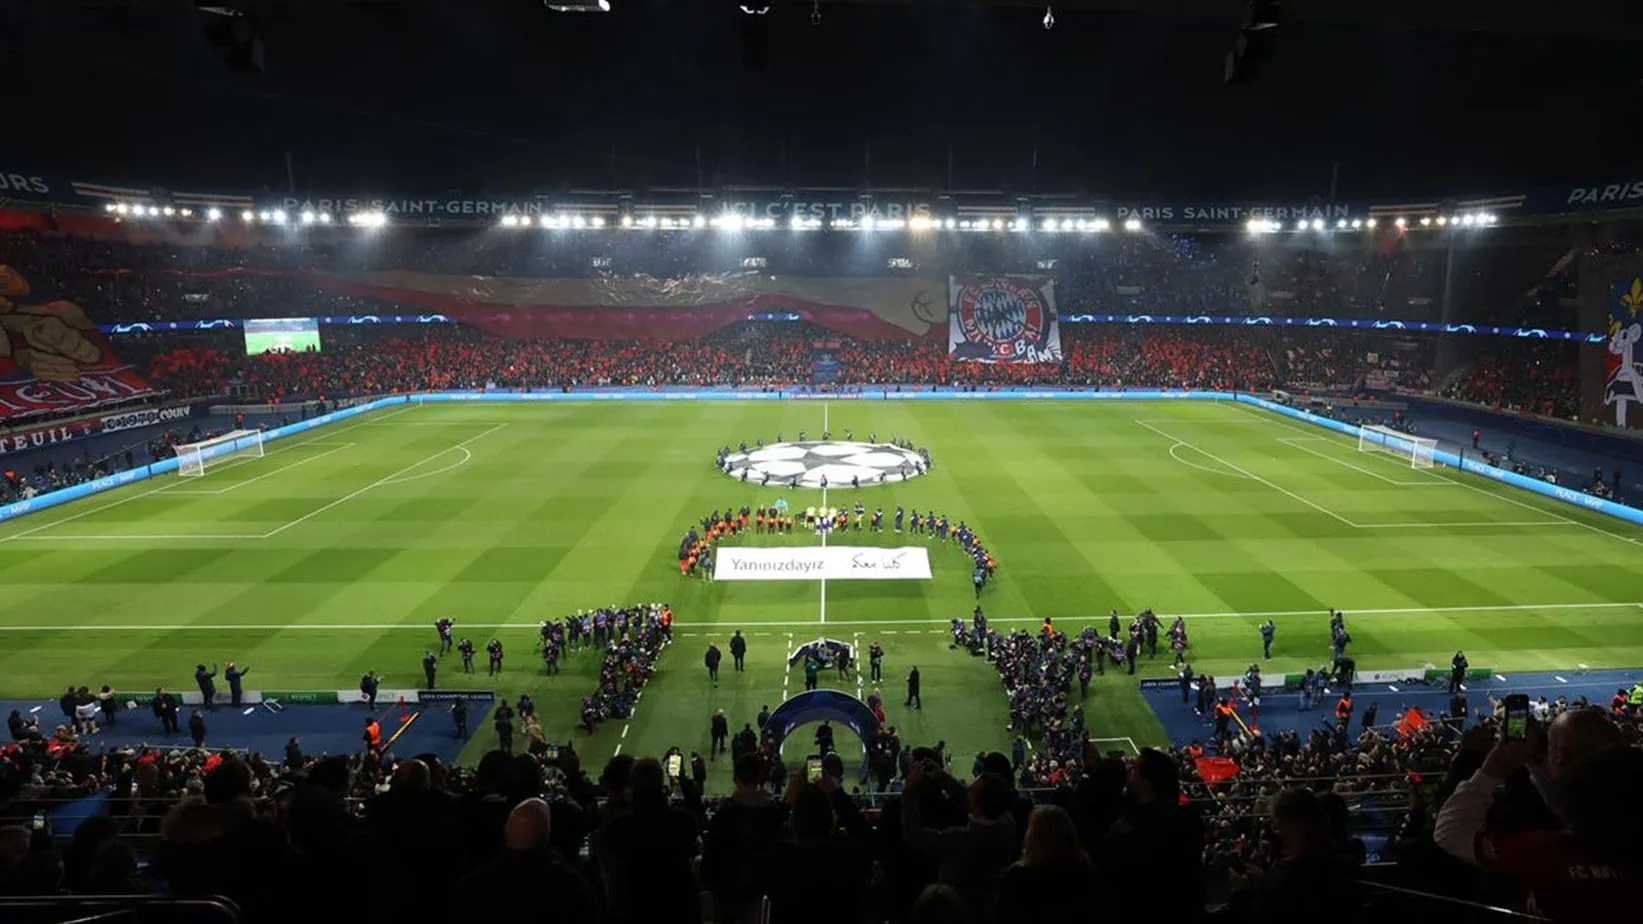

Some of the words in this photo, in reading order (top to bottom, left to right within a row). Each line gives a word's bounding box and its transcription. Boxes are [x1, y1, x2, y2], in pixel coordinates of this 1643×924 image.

[1567, 182, 1643, 205] PARIS
[283, 198, 358, 213] PARIS
[371, 199, 542, 215] SAINT-GERMAIN
[849, 203, 931, 220] PARIS
[1117, 206, 1174, 219] PARIS
[1183, 204, 1349, 220] SAINT-GERMAIN
